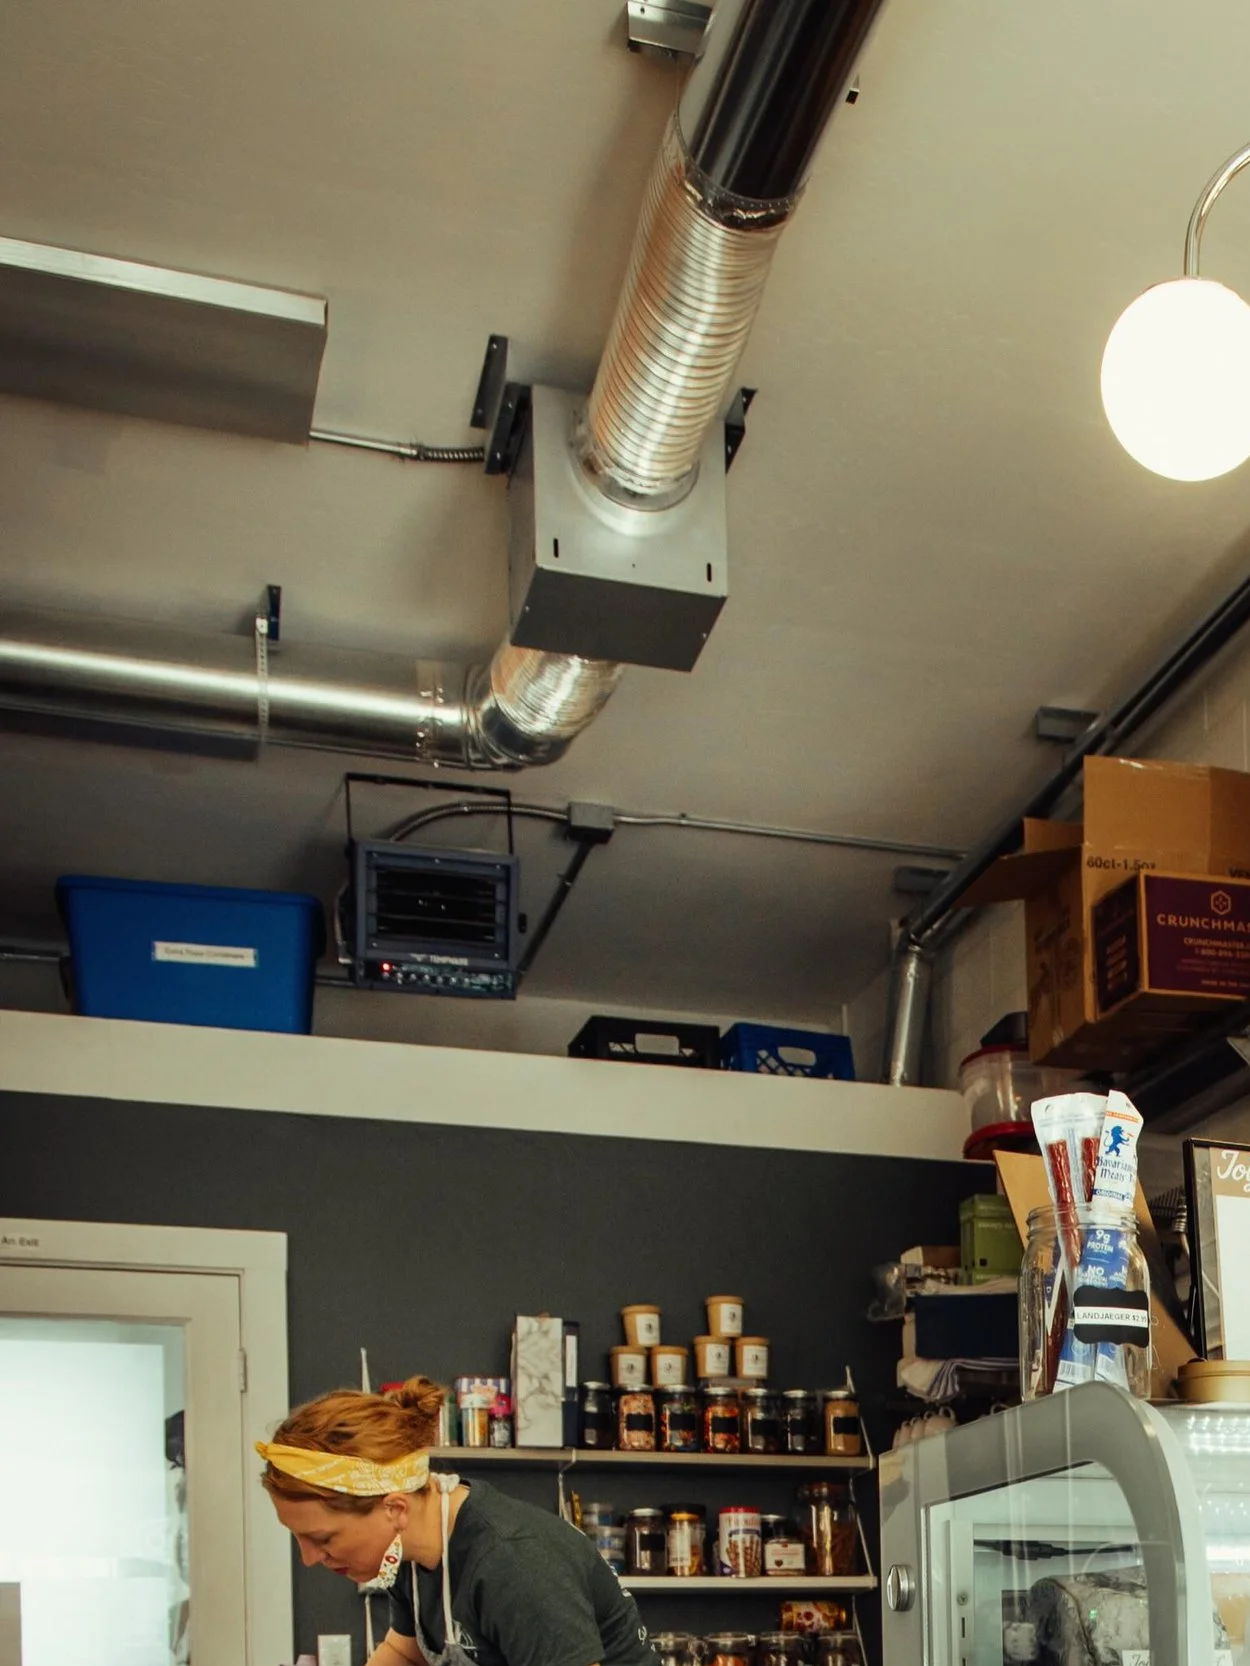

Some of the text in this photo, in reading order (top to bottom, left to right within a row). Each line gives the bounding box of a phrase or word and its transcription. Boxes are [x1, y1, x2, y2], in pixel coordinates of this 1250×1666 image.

[1095, 1230, 1111, 1244] 9g
[1086, 1240, 1114, 1252] PROTEIN
[1087, 1265, 1104, 1276] NO
[1077, 1312, 1130, 1320] LANDJAEGER
